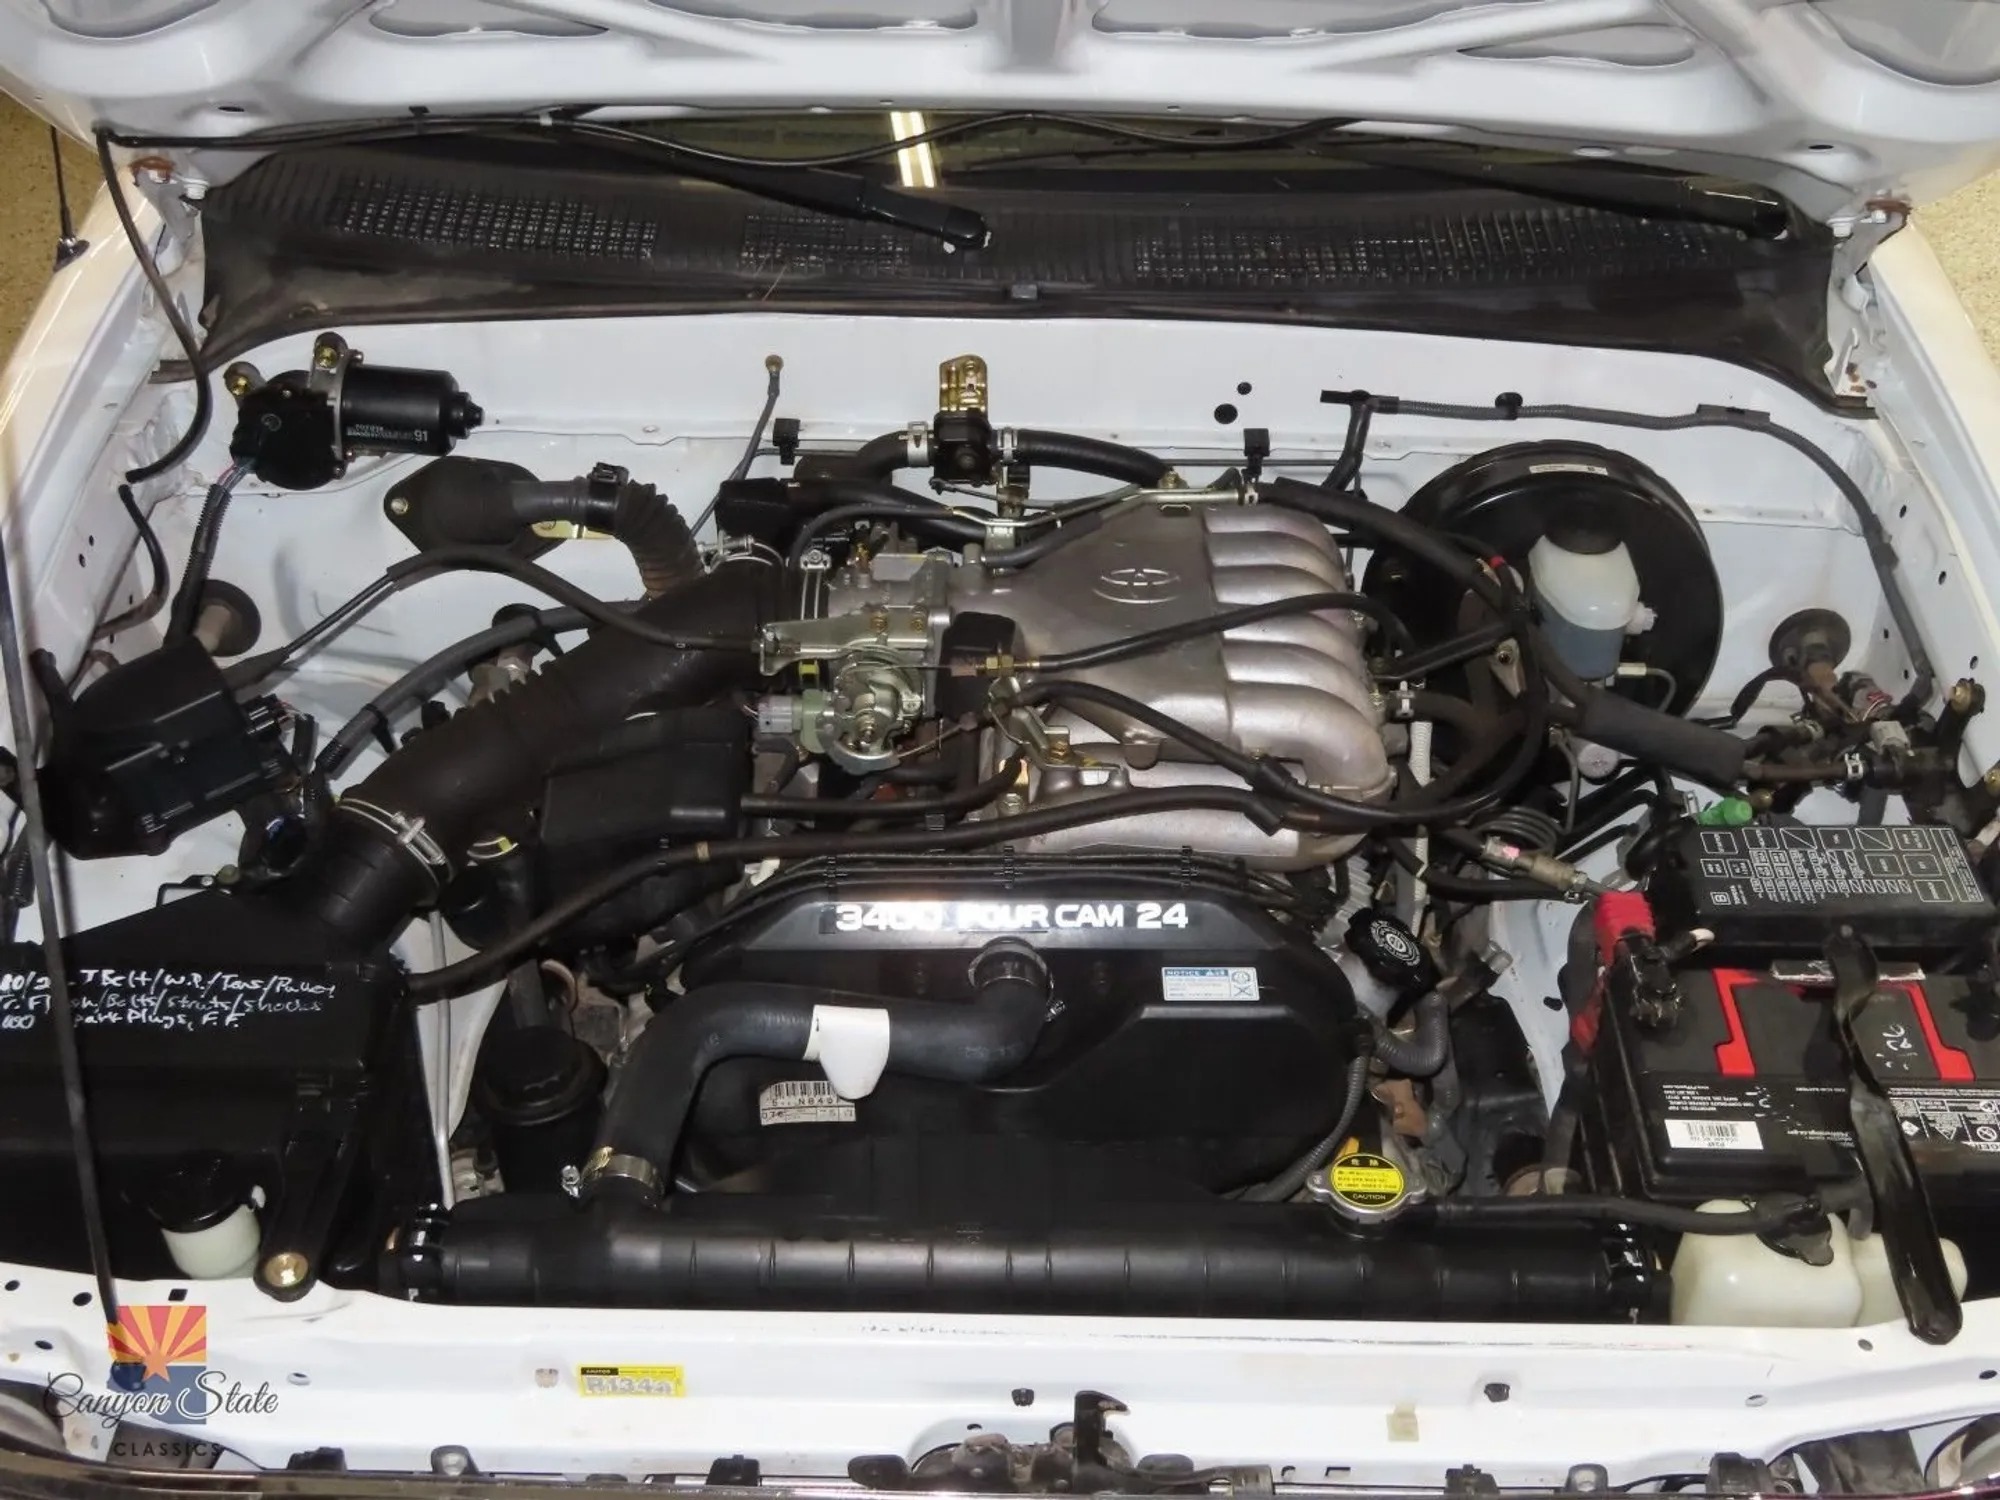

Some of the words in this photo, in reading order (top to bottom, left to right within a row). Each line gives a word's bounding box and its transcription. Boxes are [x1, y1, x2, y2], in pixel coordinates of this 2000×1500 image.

[414, 429, 428, 442] 91
[836, 903, 943, 931] 3400
[1055, 903, 1124, 928] CAM
[1136, 902, 1189, 929] 24
